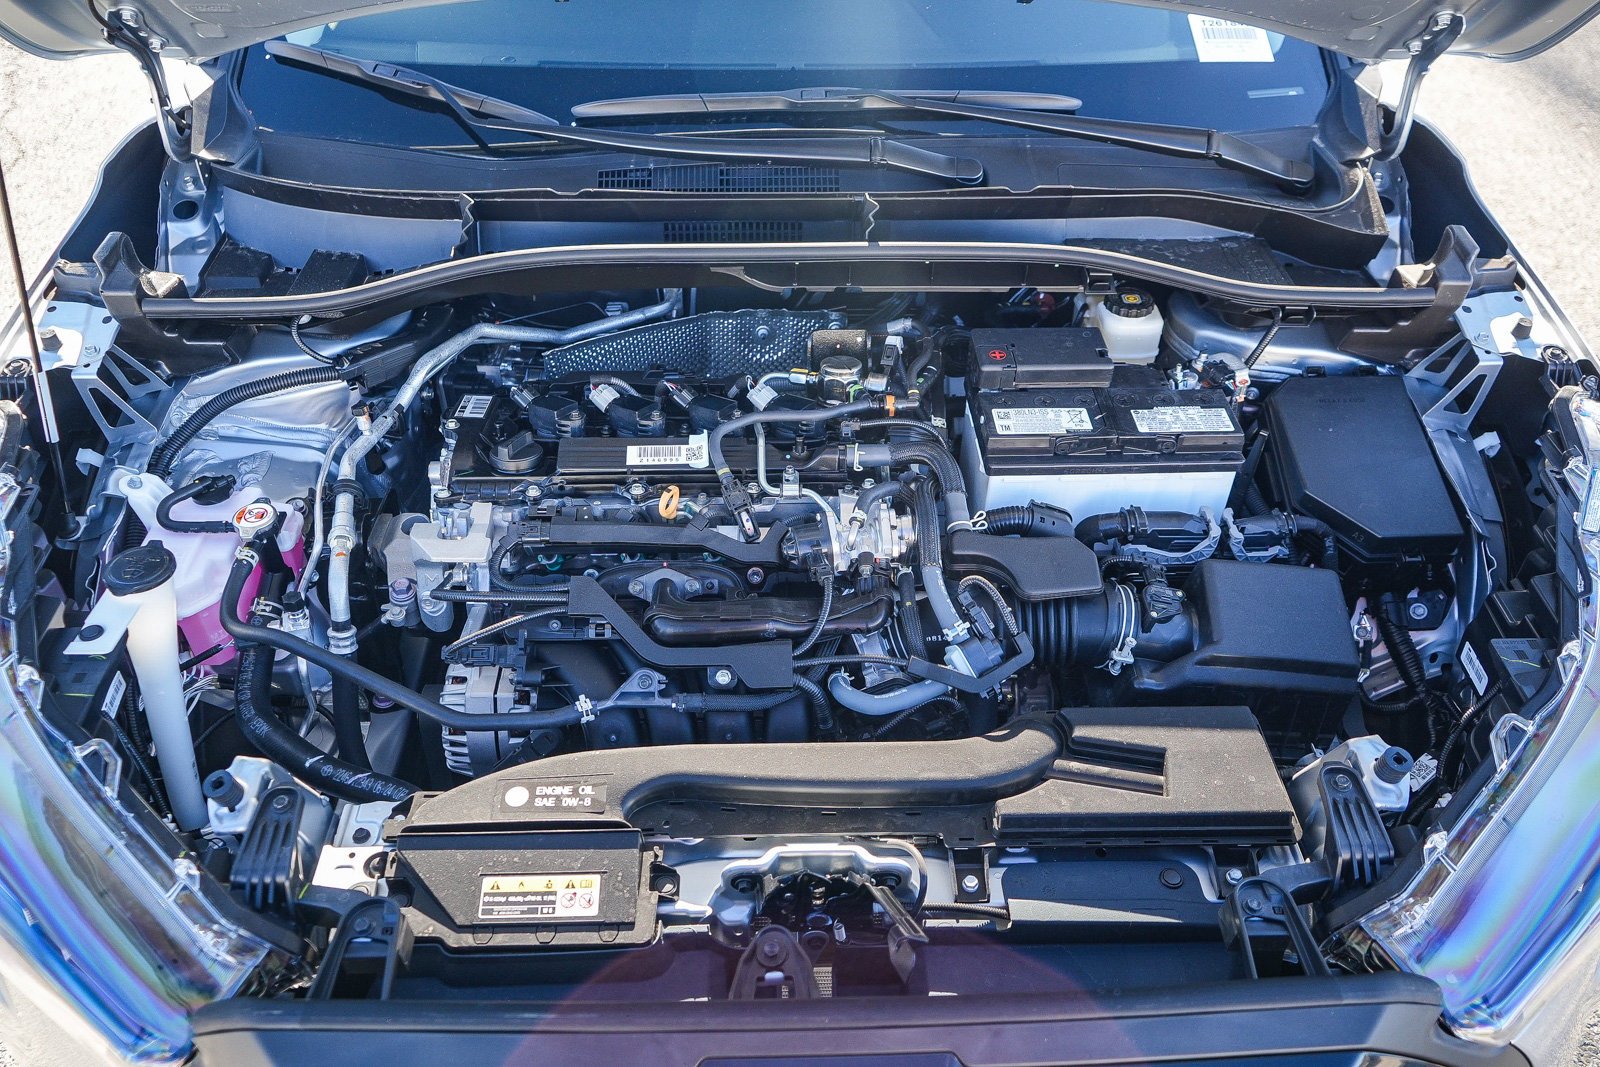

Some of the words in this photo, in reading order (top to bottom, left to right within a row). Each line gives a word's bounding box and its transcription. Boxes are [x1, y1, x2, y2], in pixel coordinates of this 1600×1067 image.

[1000, 424, 1011, 432] TM
[536, 786, 573, 795] ENGINE
[578, 786, 595, 794] OIL
[534, 797, 555, 806] SAE
[561, 797, 592, 806] 0W-8
